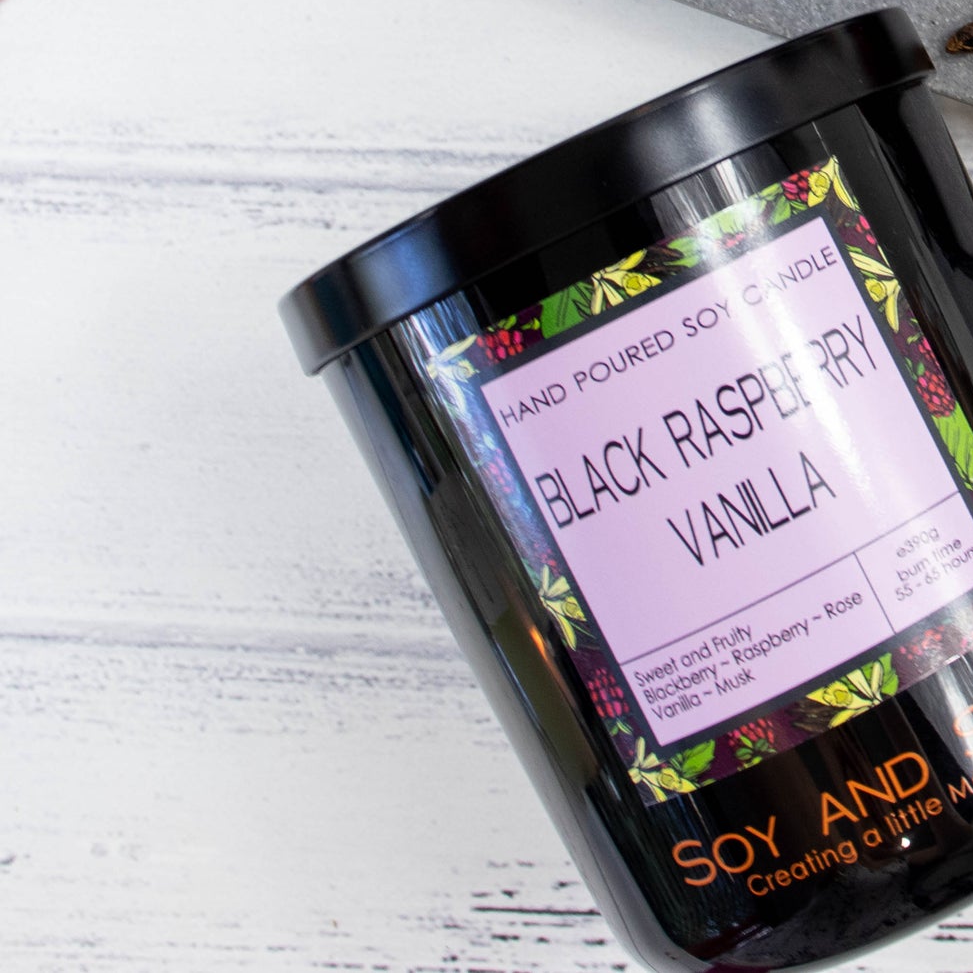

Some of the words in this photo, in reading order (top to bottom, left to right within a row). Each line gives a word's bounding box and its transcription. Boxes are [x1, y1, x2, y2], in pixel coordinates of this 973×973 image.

[500, 382, 567, 428] HAND
[573, 330, 676, 393] POURED
[681, 299, 732, 338] SOY
[742, 245, 838, 306] CANDLE
[535, 427, 669, 529] BLACK
[662, 314, 878, 469] RASPBERRY
[666, 451, 838, 567] VANILLA
[633, 657, 679, 689] Sweet
[680, 641, 713, 669] and
[711, 624, 753, 654] Fruity
[642, 662, 718, 705] Blackberry
[731, 618, 811, 667] Raspberry
[823, 591, 864, 620] Rose
[651, 693, 702, 722] Vanilla
[715, 668, 757, 698] Musk
[671, 815, 782, 888] SOY
[819, 751, 931, 836] AND
[746, 838, 859, 898] Creating
[863, 826, 884, 848] a
[884, 793, 944, 842] little
